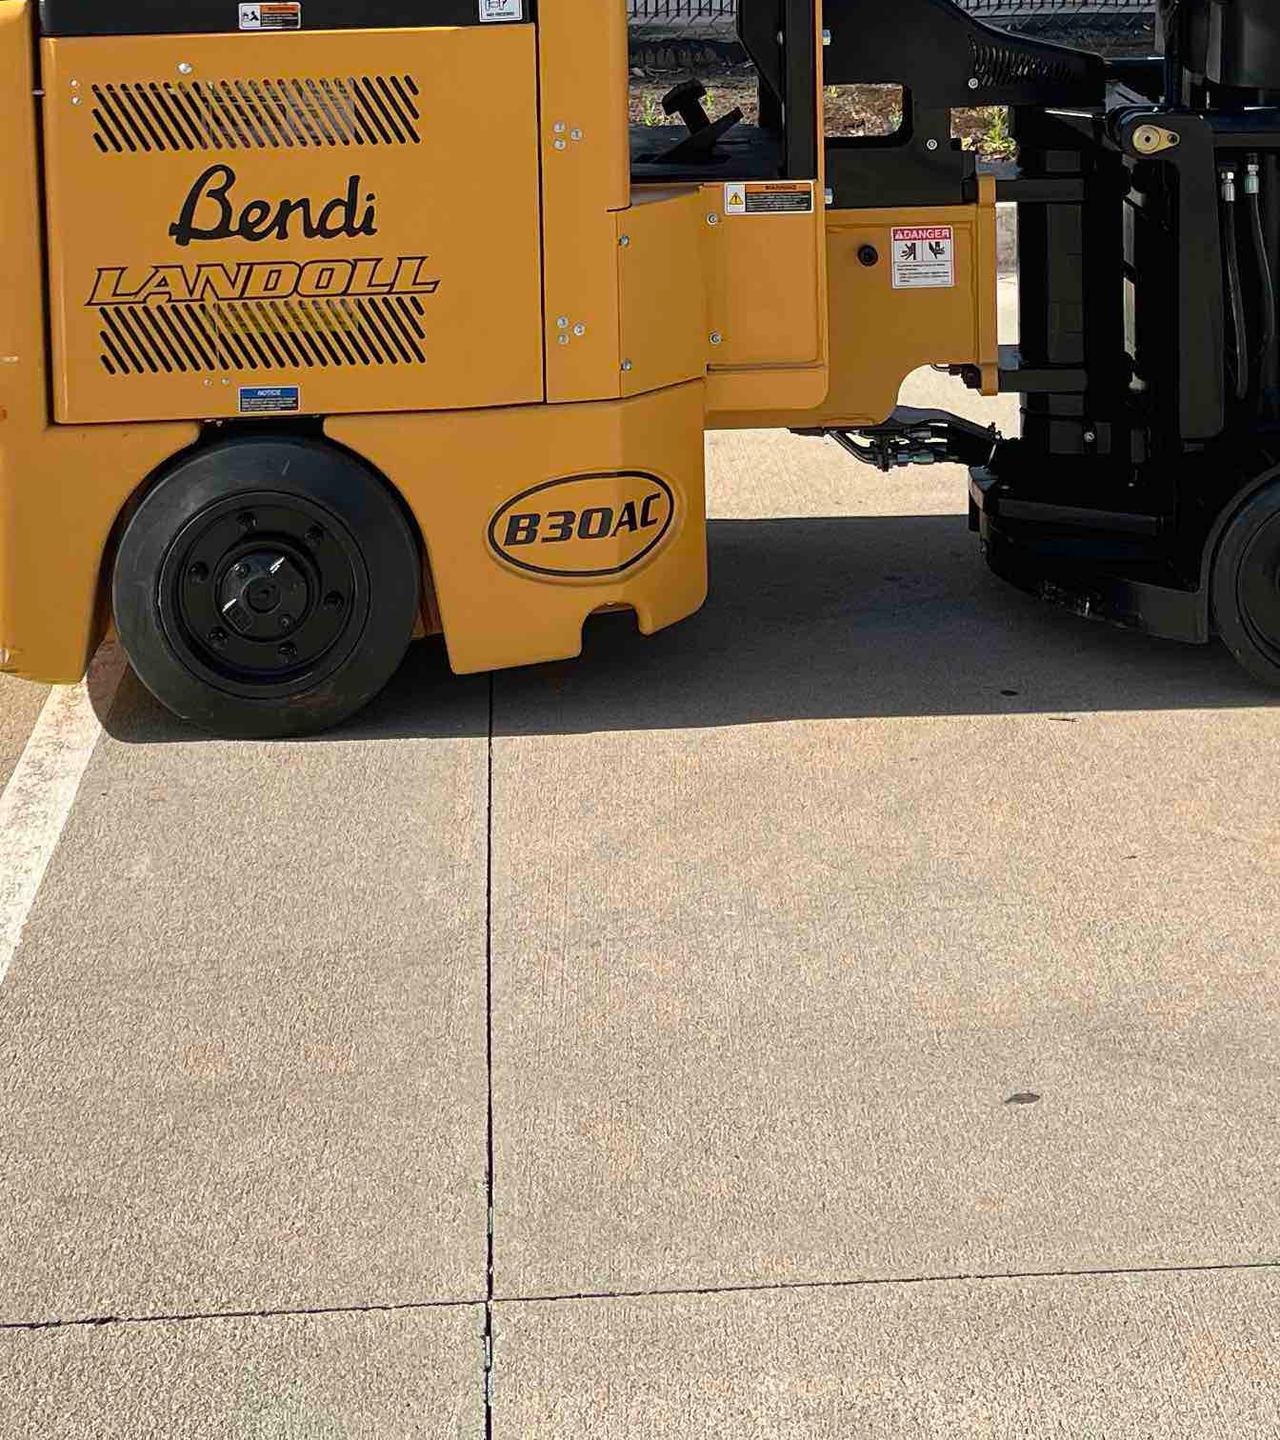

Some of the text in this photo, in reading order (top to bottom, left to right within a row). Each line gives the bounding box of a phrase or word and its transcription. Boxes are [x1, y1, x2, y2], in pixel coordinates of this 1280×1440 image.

[169, 164, 378, 246] Bendi
[903, 228, 950, 240] DANGER
[84, 256, 441, 306] LANDOLL
[503, 492, 661, 547] B30AC
